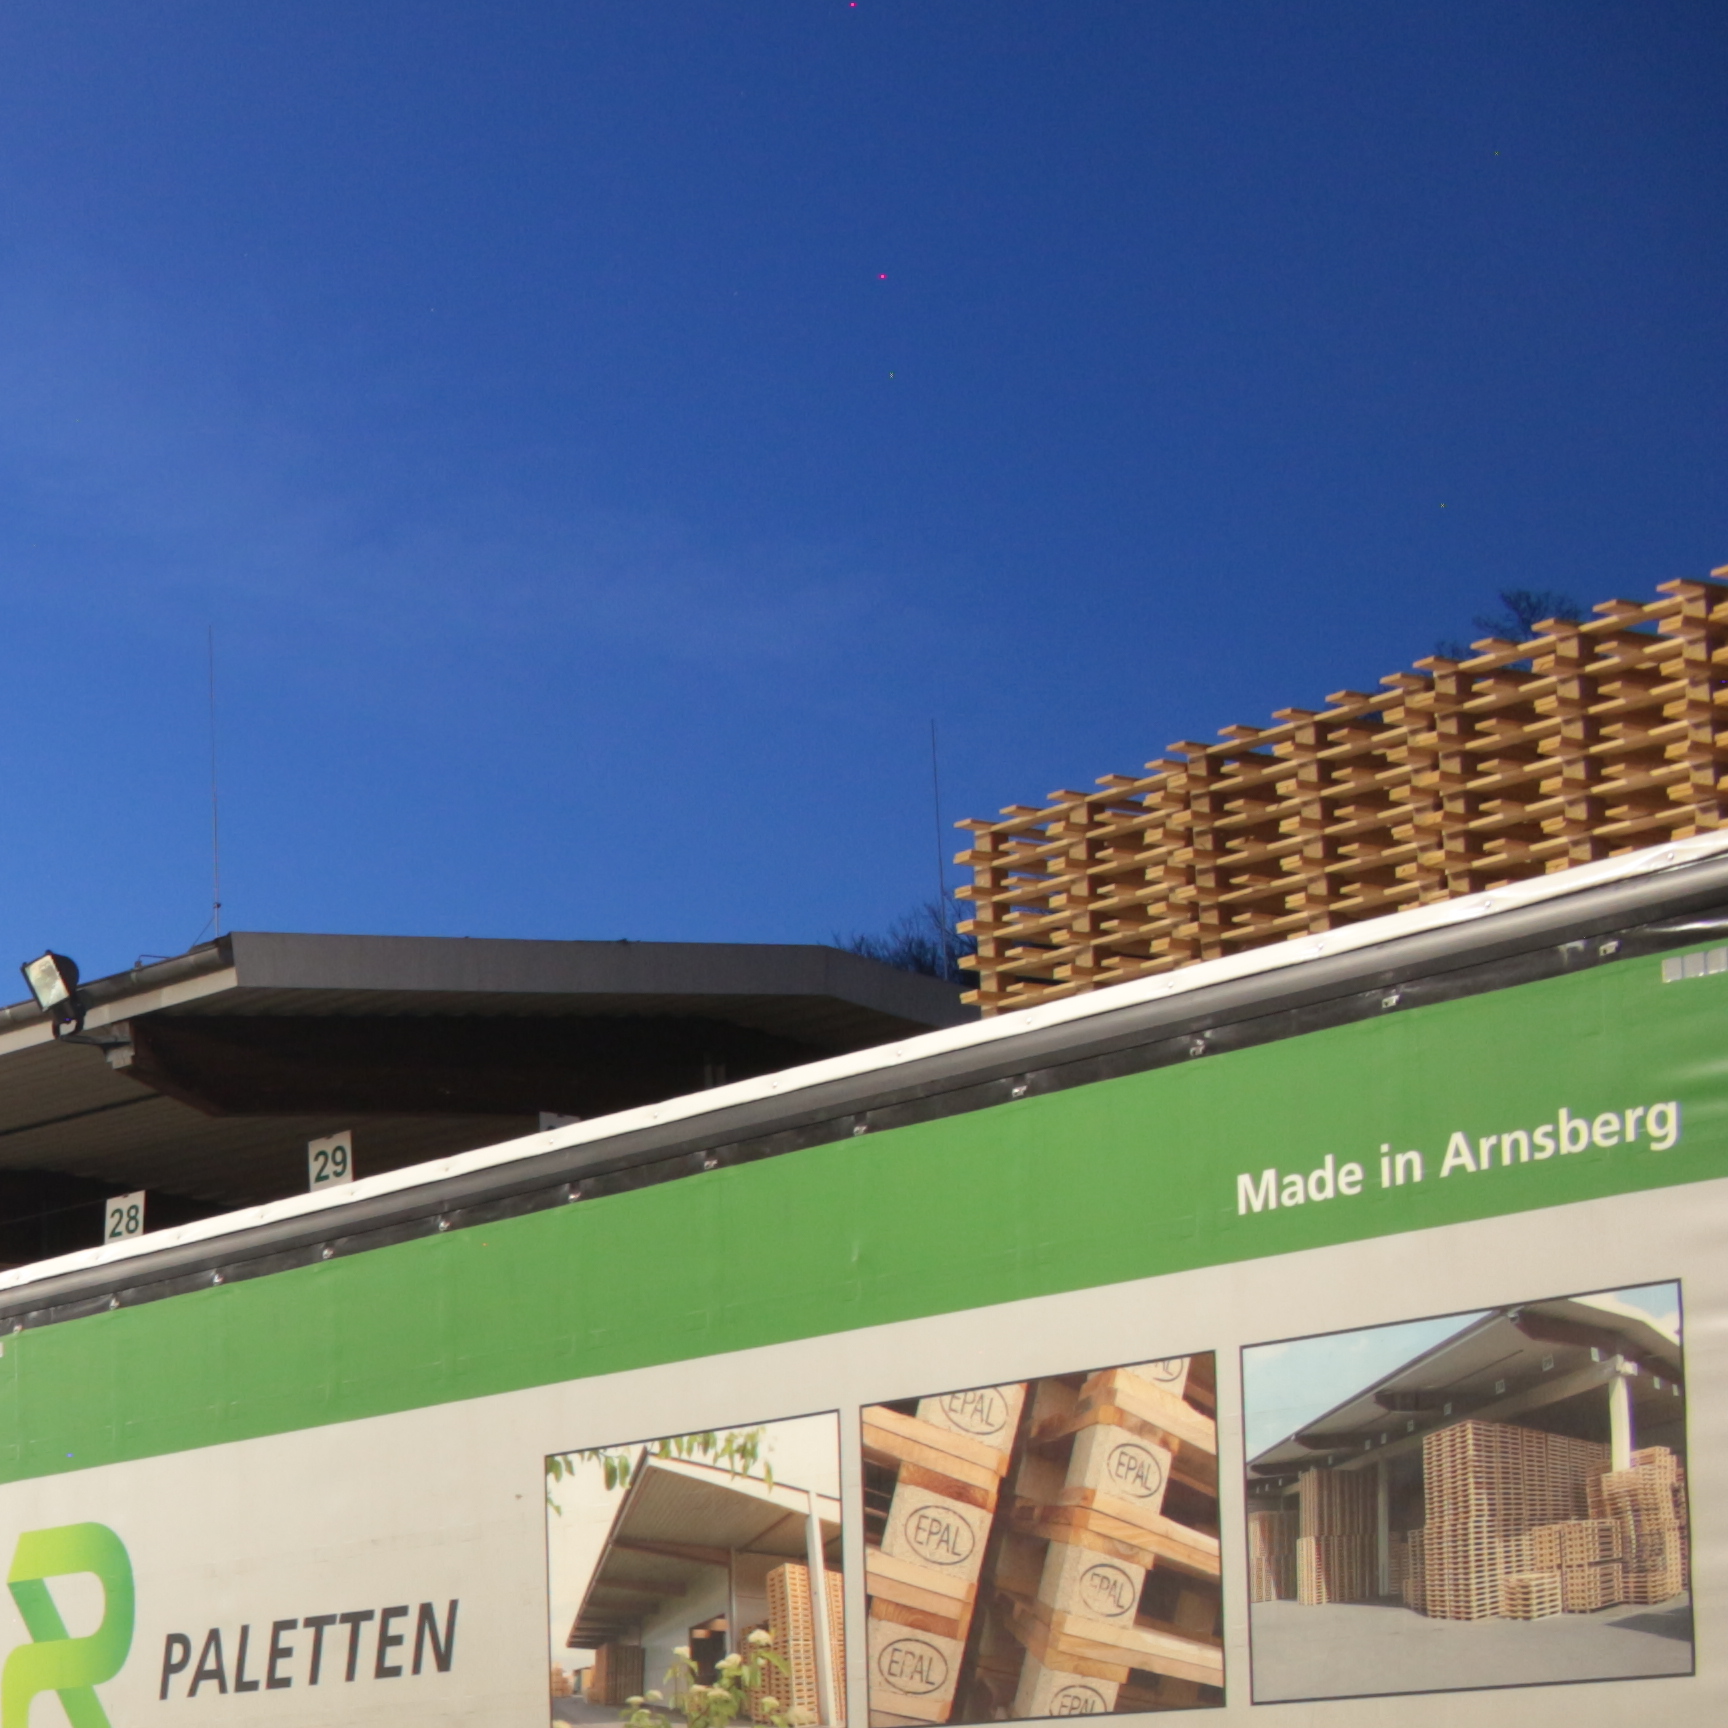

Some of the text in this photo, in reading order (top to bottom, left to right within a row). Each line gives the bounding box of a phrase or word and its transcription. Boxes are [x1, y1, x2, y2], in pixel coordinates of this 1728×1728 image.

[313, 1145, 348, 1184] 29
[1236, 1099, 1680, 1217] Made in Arnsberg
[108, 1204, 140, 1239] 28
[947, 1391, 995, 1428] EPAL
[1115, 1452, 1153, 1492] EPAL
[913, 1515, 963, 1557] EPAL
[1087, 1572, 1126, 1610] EPAL
[158, 1598, 460, 1701] PALETTEN
[886, 1648, 937, 1687] EPAL
